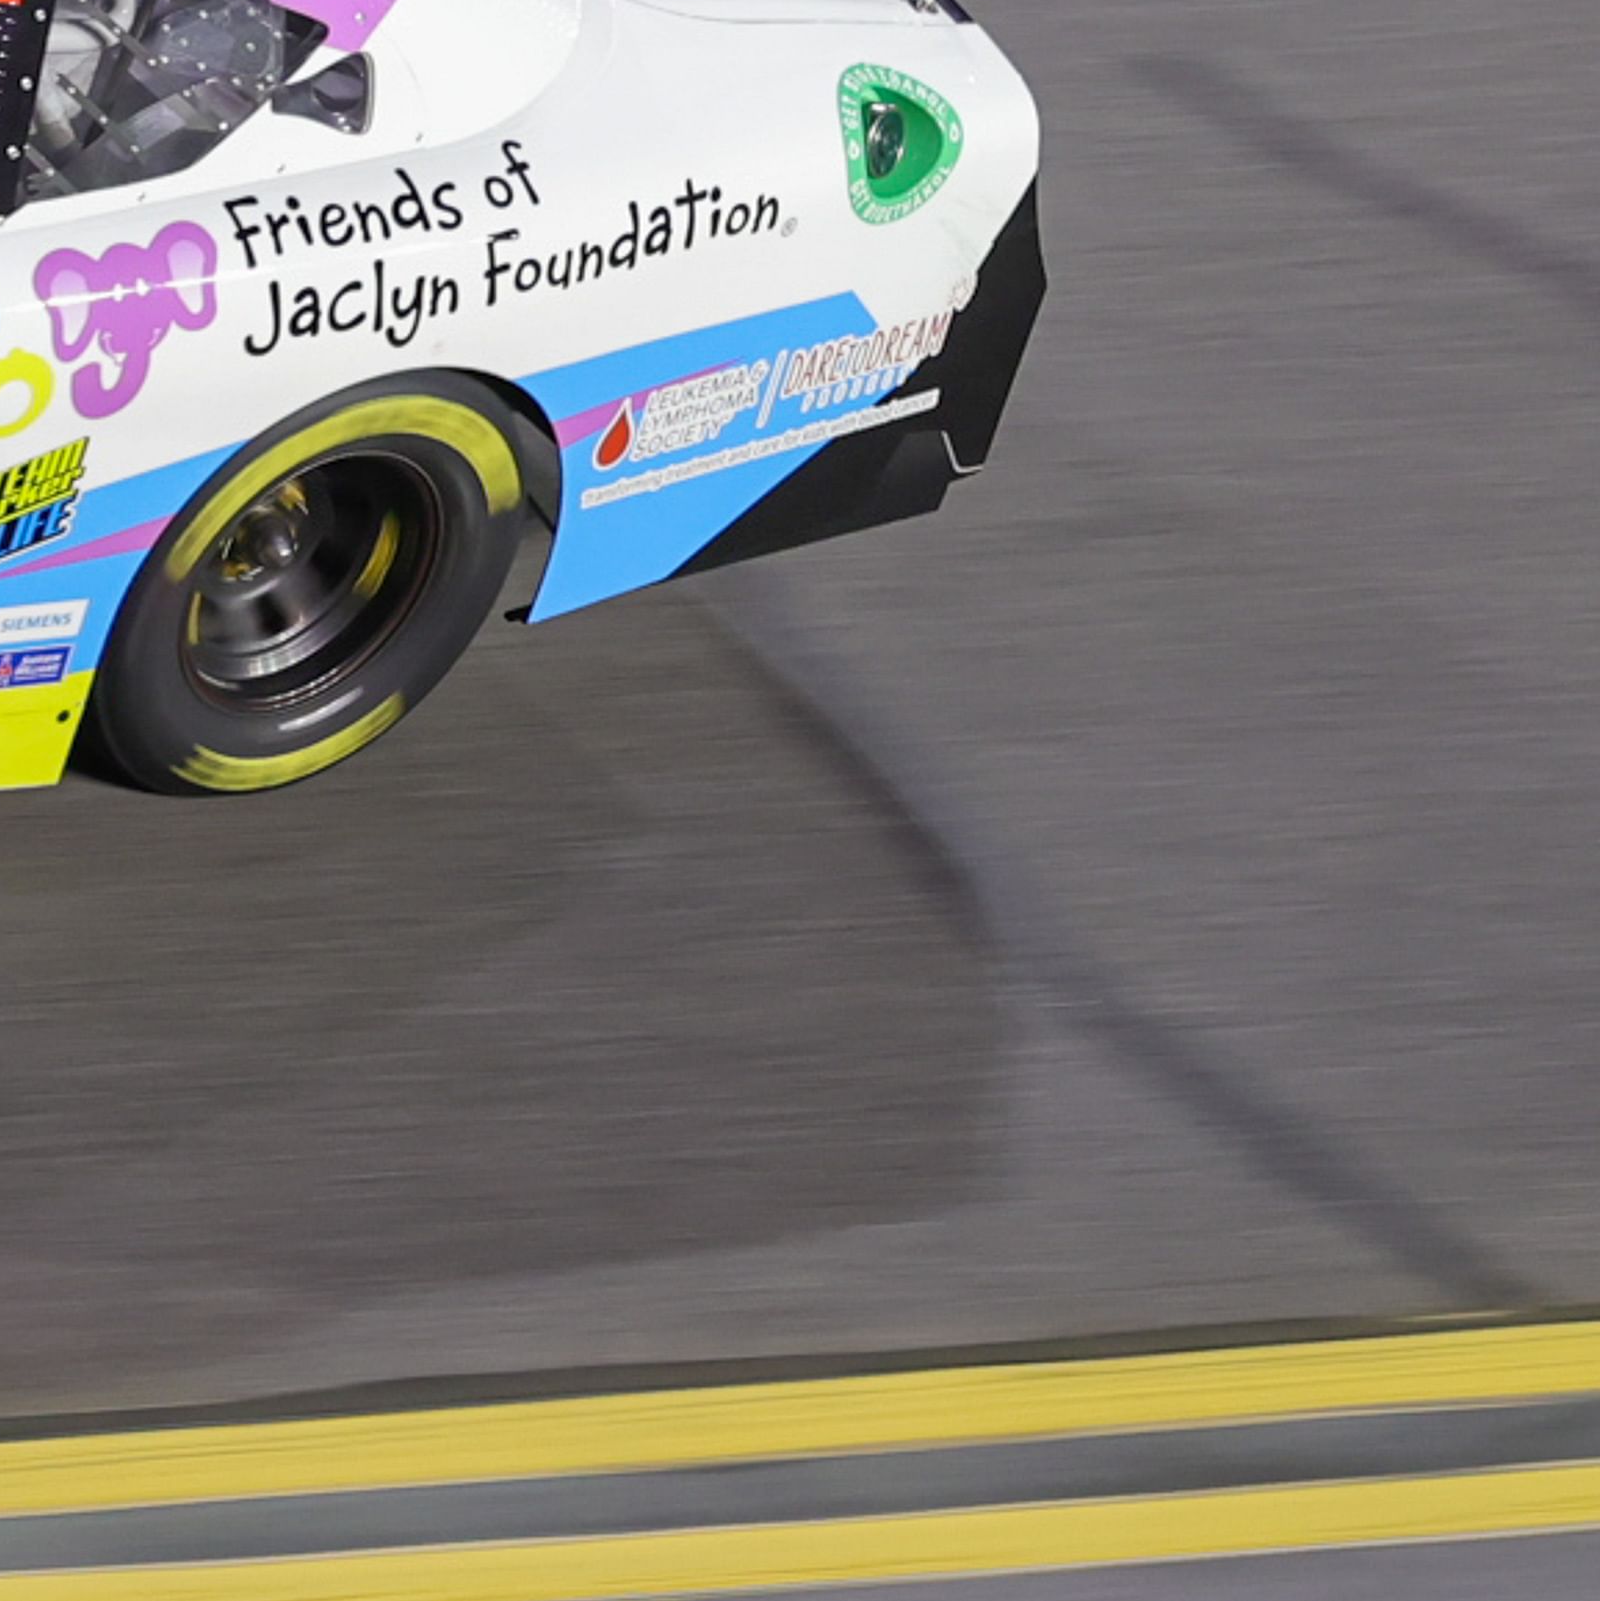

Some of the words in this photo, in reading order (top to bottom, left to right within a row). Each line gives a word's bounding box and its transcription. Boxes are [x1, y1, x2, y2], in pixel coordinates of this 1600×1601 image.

[224, 168, 463, 268] Friends
[483, 141, 540, 207] of
[244, 260, 459, 356] Jaclyn
[639, 387, 756, 437] LYMPHOMA
[648, 367, 746, 415] LEUKEMIA
[632, 415, 721, 460] SOCIETY
[1, 613, 73, 632] SIEMENS
